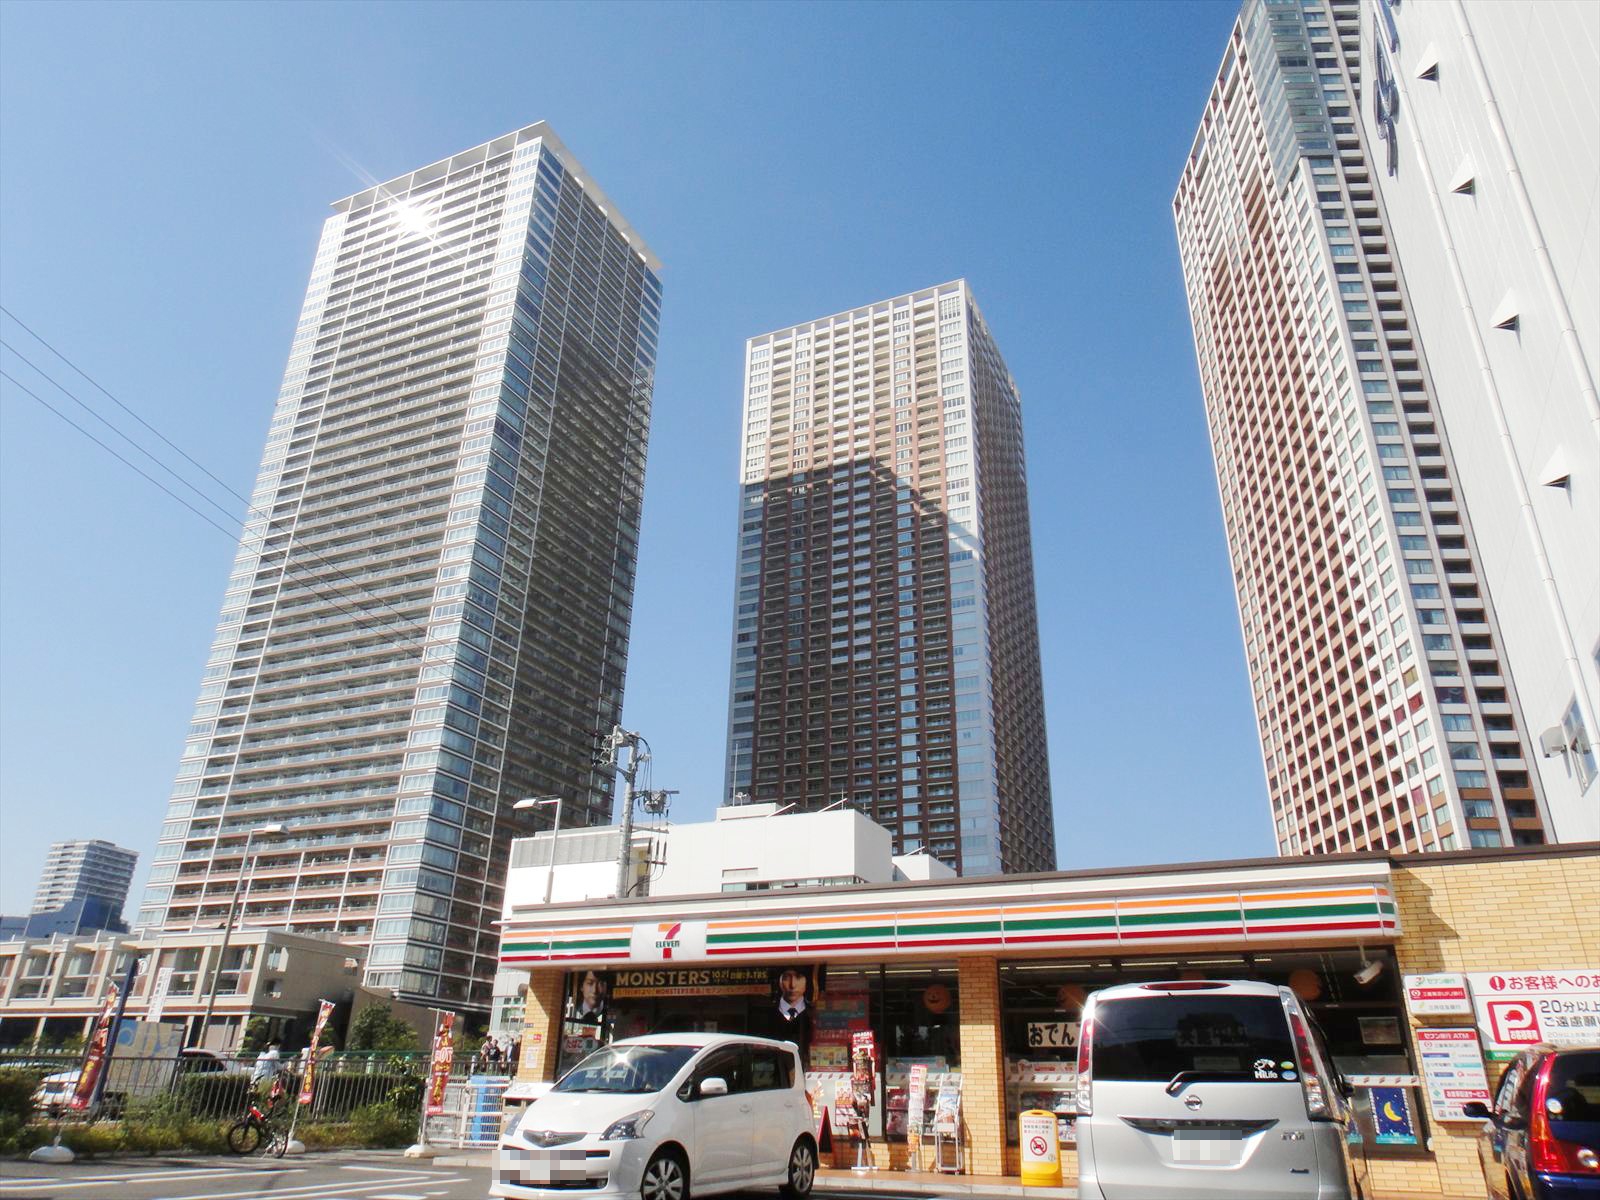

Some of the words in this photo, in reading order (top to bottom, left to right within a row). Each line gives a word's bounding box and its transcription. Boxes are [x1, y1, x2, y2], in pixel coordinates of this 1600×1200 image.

[616, 971, 710, 986] MONSTERS
[1030, 1024, 1075, 1045] おでん
